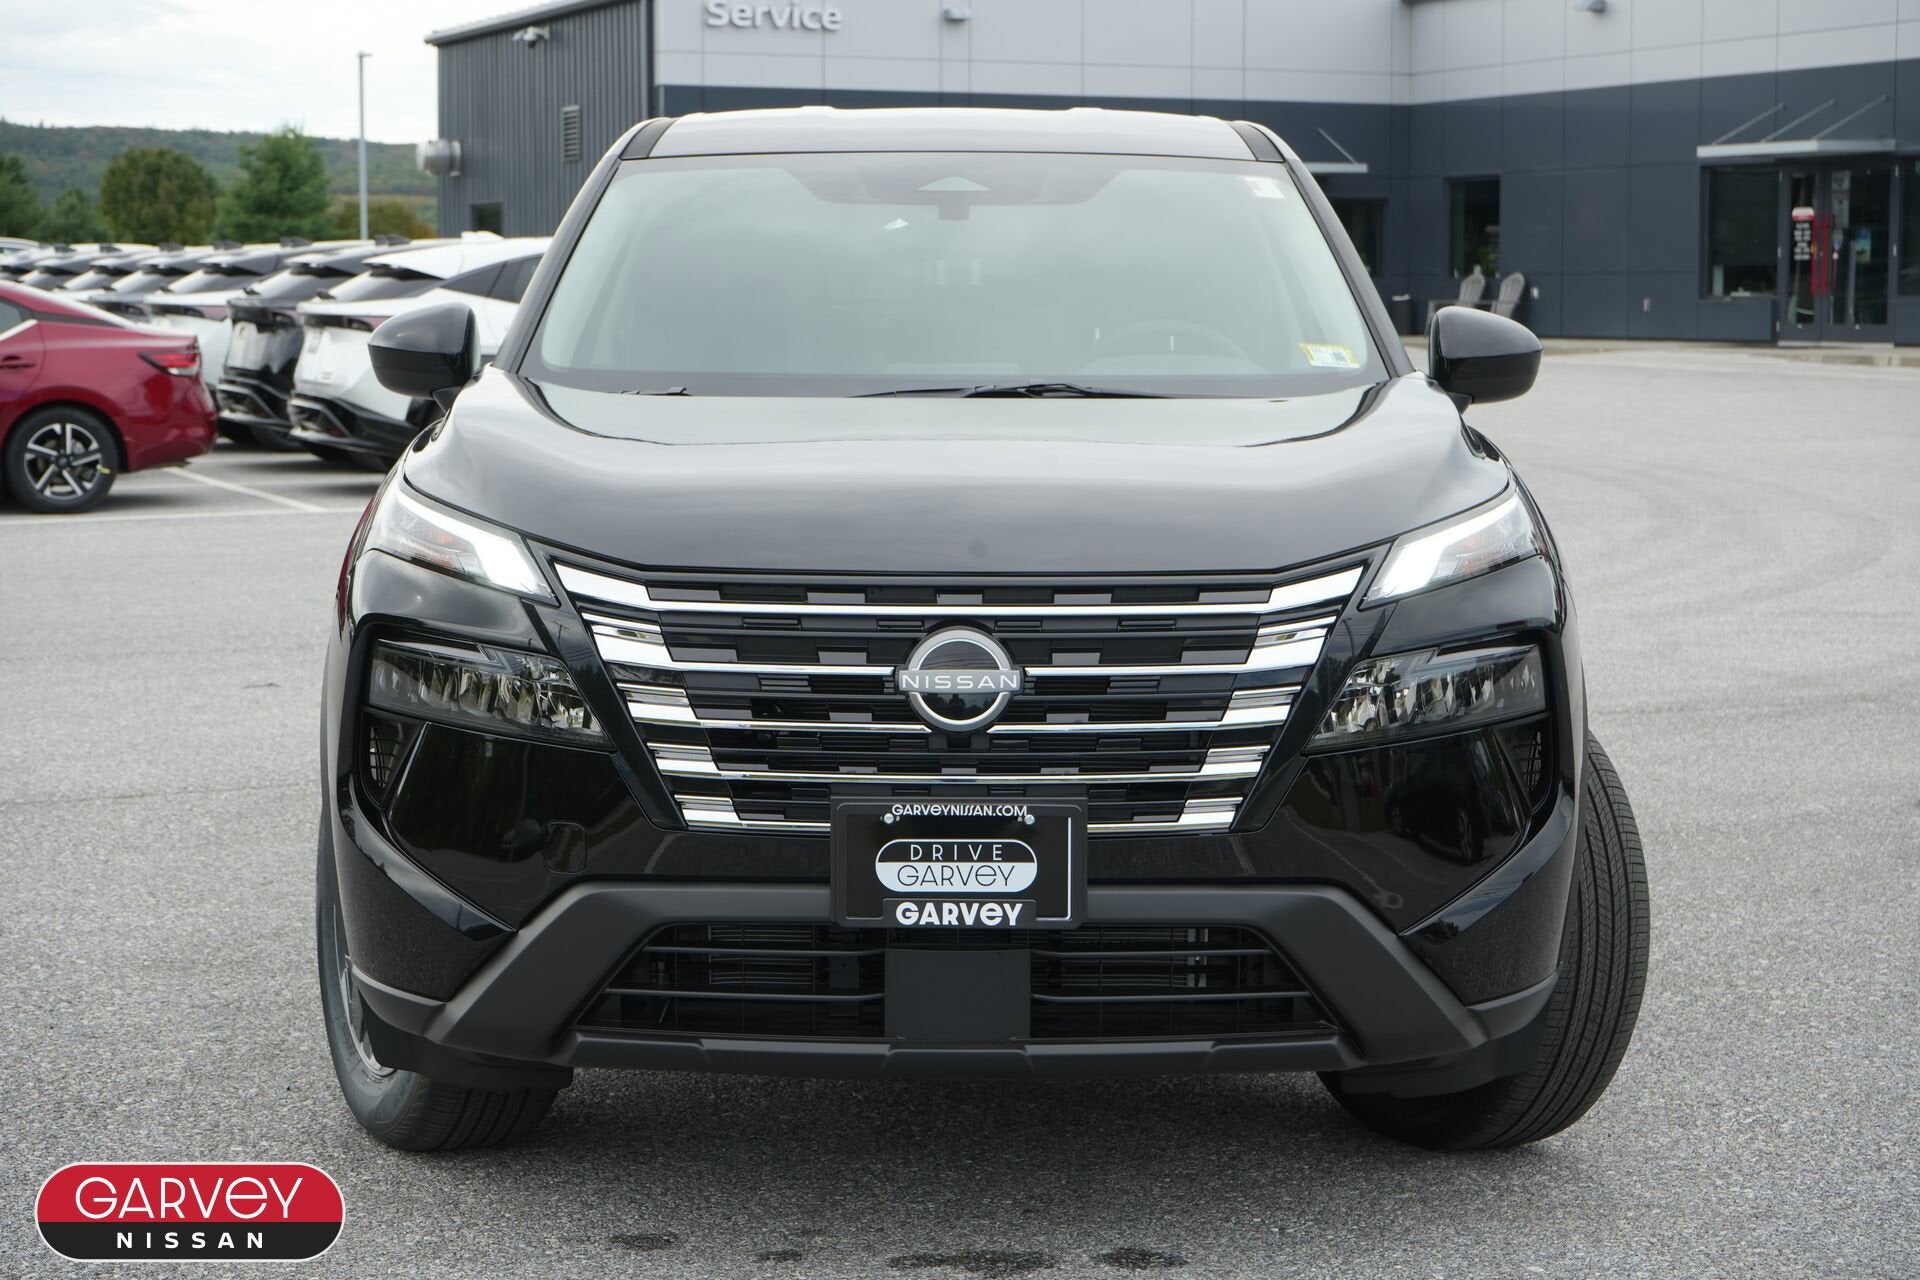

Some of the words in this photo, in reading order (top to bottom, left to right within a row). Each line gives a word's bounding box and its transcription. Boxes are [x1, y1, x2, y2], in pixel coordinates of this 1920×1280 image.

[706, 0, 842, 31] Service
[902, 675, 1017, 689] NISSAN
[910, 844, 1003, 861] DRIVE
